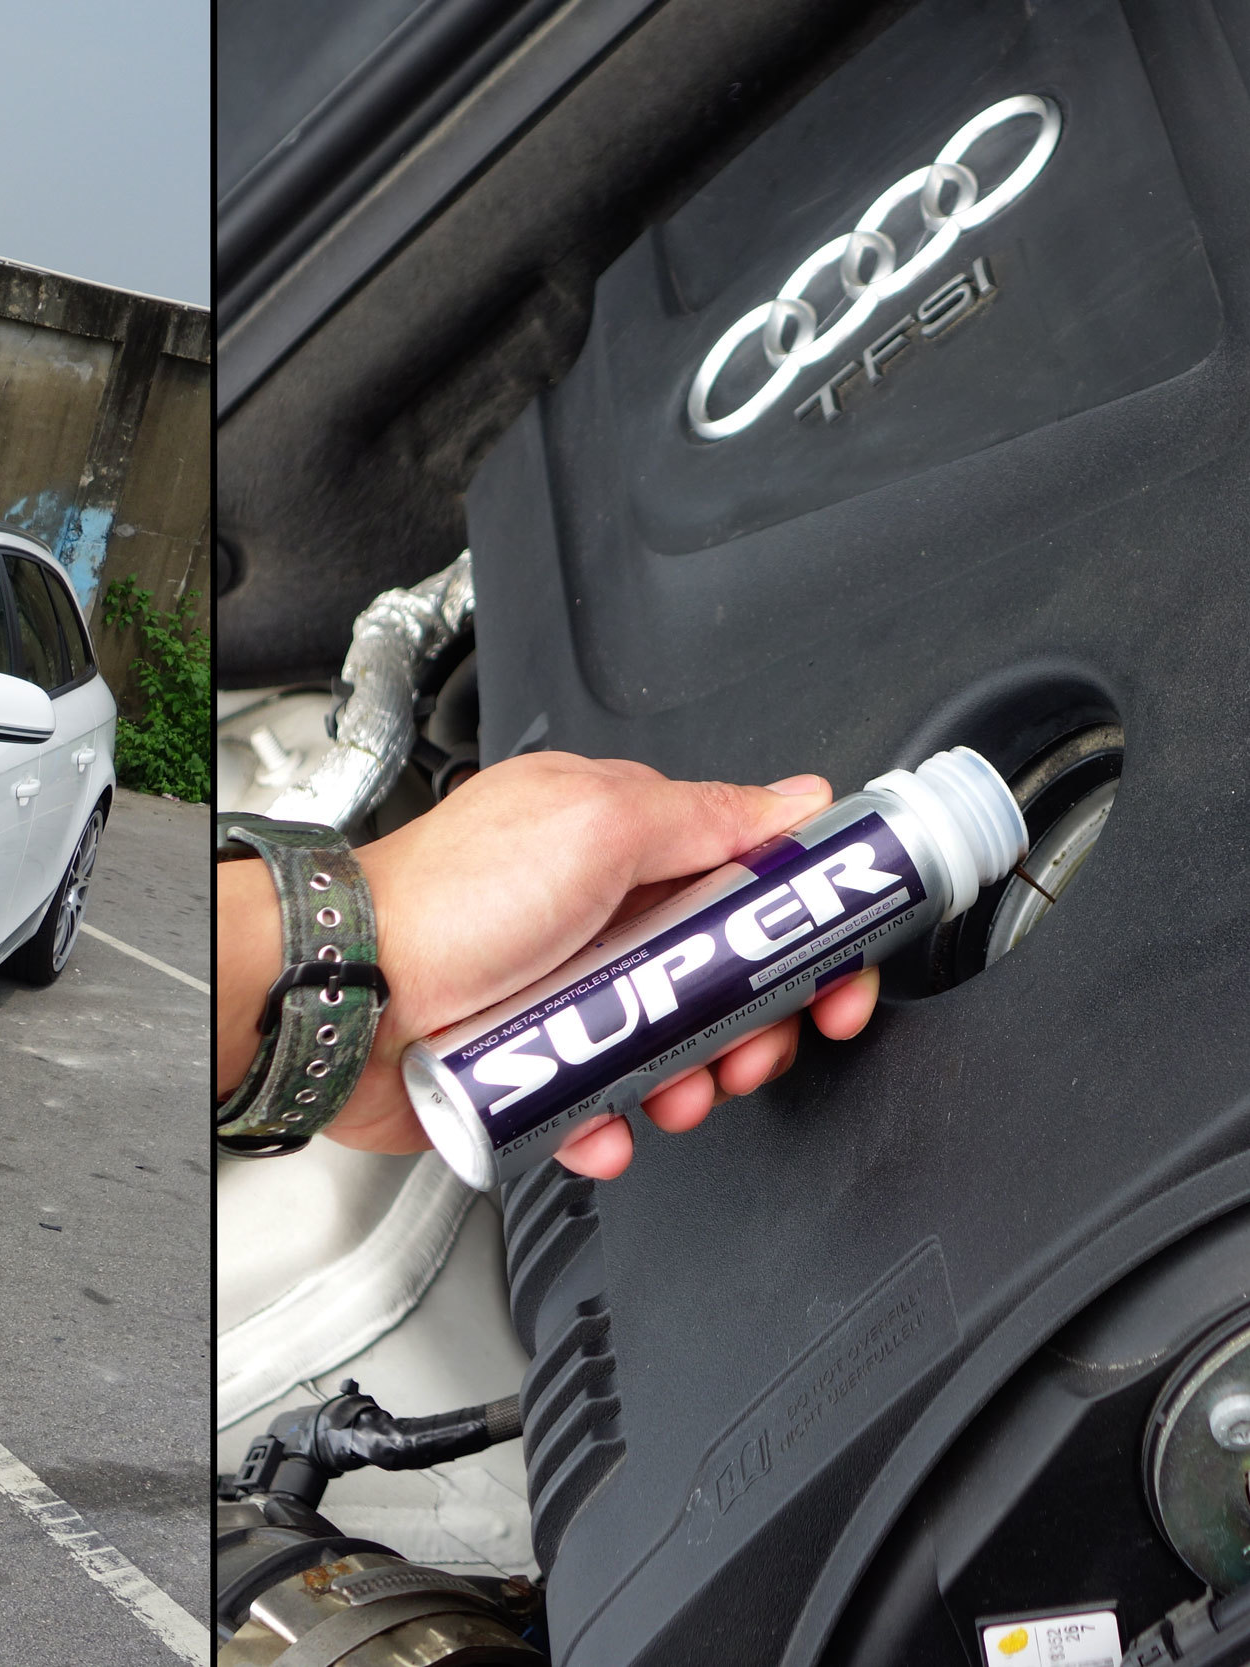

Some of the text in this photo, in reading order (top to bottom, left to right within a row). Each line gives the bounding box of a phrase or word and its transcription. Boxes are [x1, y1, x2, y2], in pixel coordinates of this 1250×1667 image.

[793, 256, 997, 424] TFSI
[471, 840, 903, 1116] SUPER
[544, 971, 610, 1014] PARTICLES
[609, 948, 650, 976] INSIDE
[756, 896, 899, 984] Engine Remetalizer
[501, 1117, 562, 1158] ACTIVE
[702, 989, 779, 1039] WITHOUT
[784, 909, 917, 993] DISASSEMBLING
